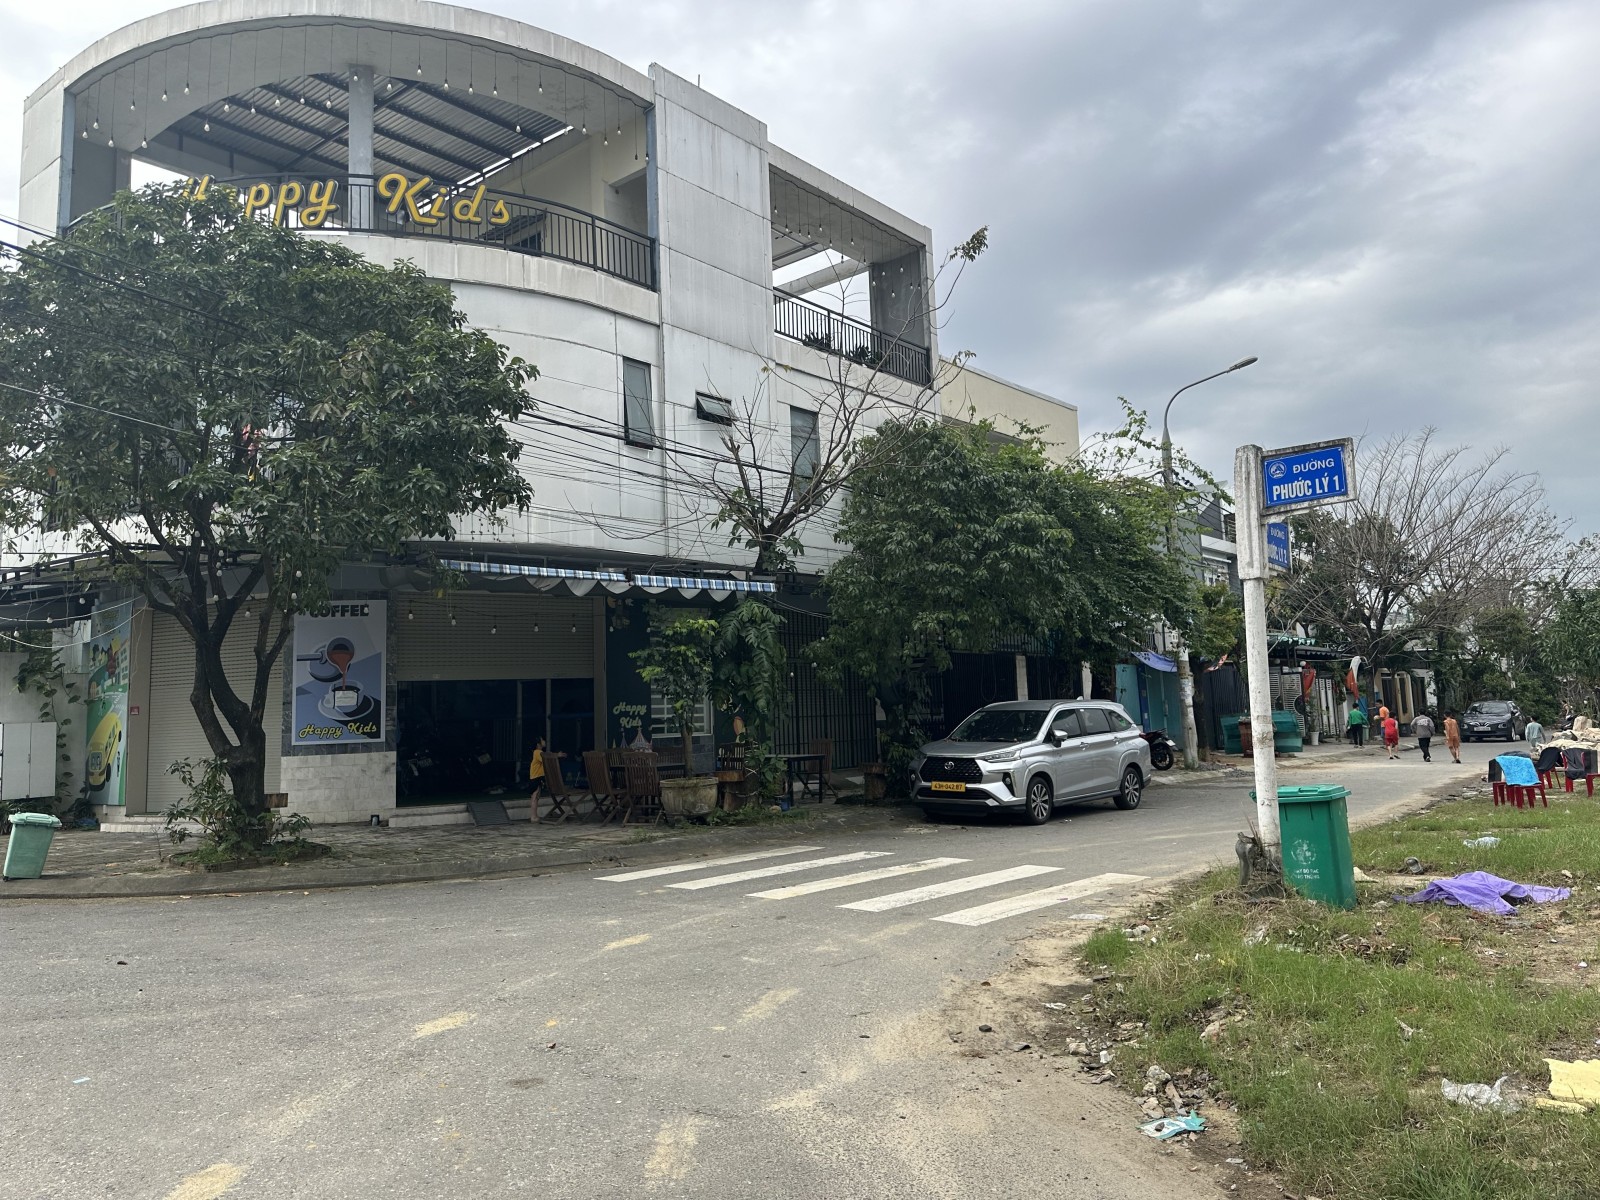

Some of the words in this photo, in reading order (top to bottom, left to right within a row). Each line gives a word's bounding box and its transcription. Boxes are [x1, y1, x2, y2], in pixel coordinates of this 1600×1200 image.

[377, 172, 512, 227] Kids
[1293, 458, 1335, 474] ĐƯỜNG
[1272, 477, 1313, 501] PHƯỚC
[1315, 472, 1329, 494] LÝ
[1333, 474, 1340, 491] 1
[613, 702, 647, 715] Happy
[299, 724, 343, 739] Happy
[347, 721, 377, 735] Kids
[620, 717, 642, 728] Kids
